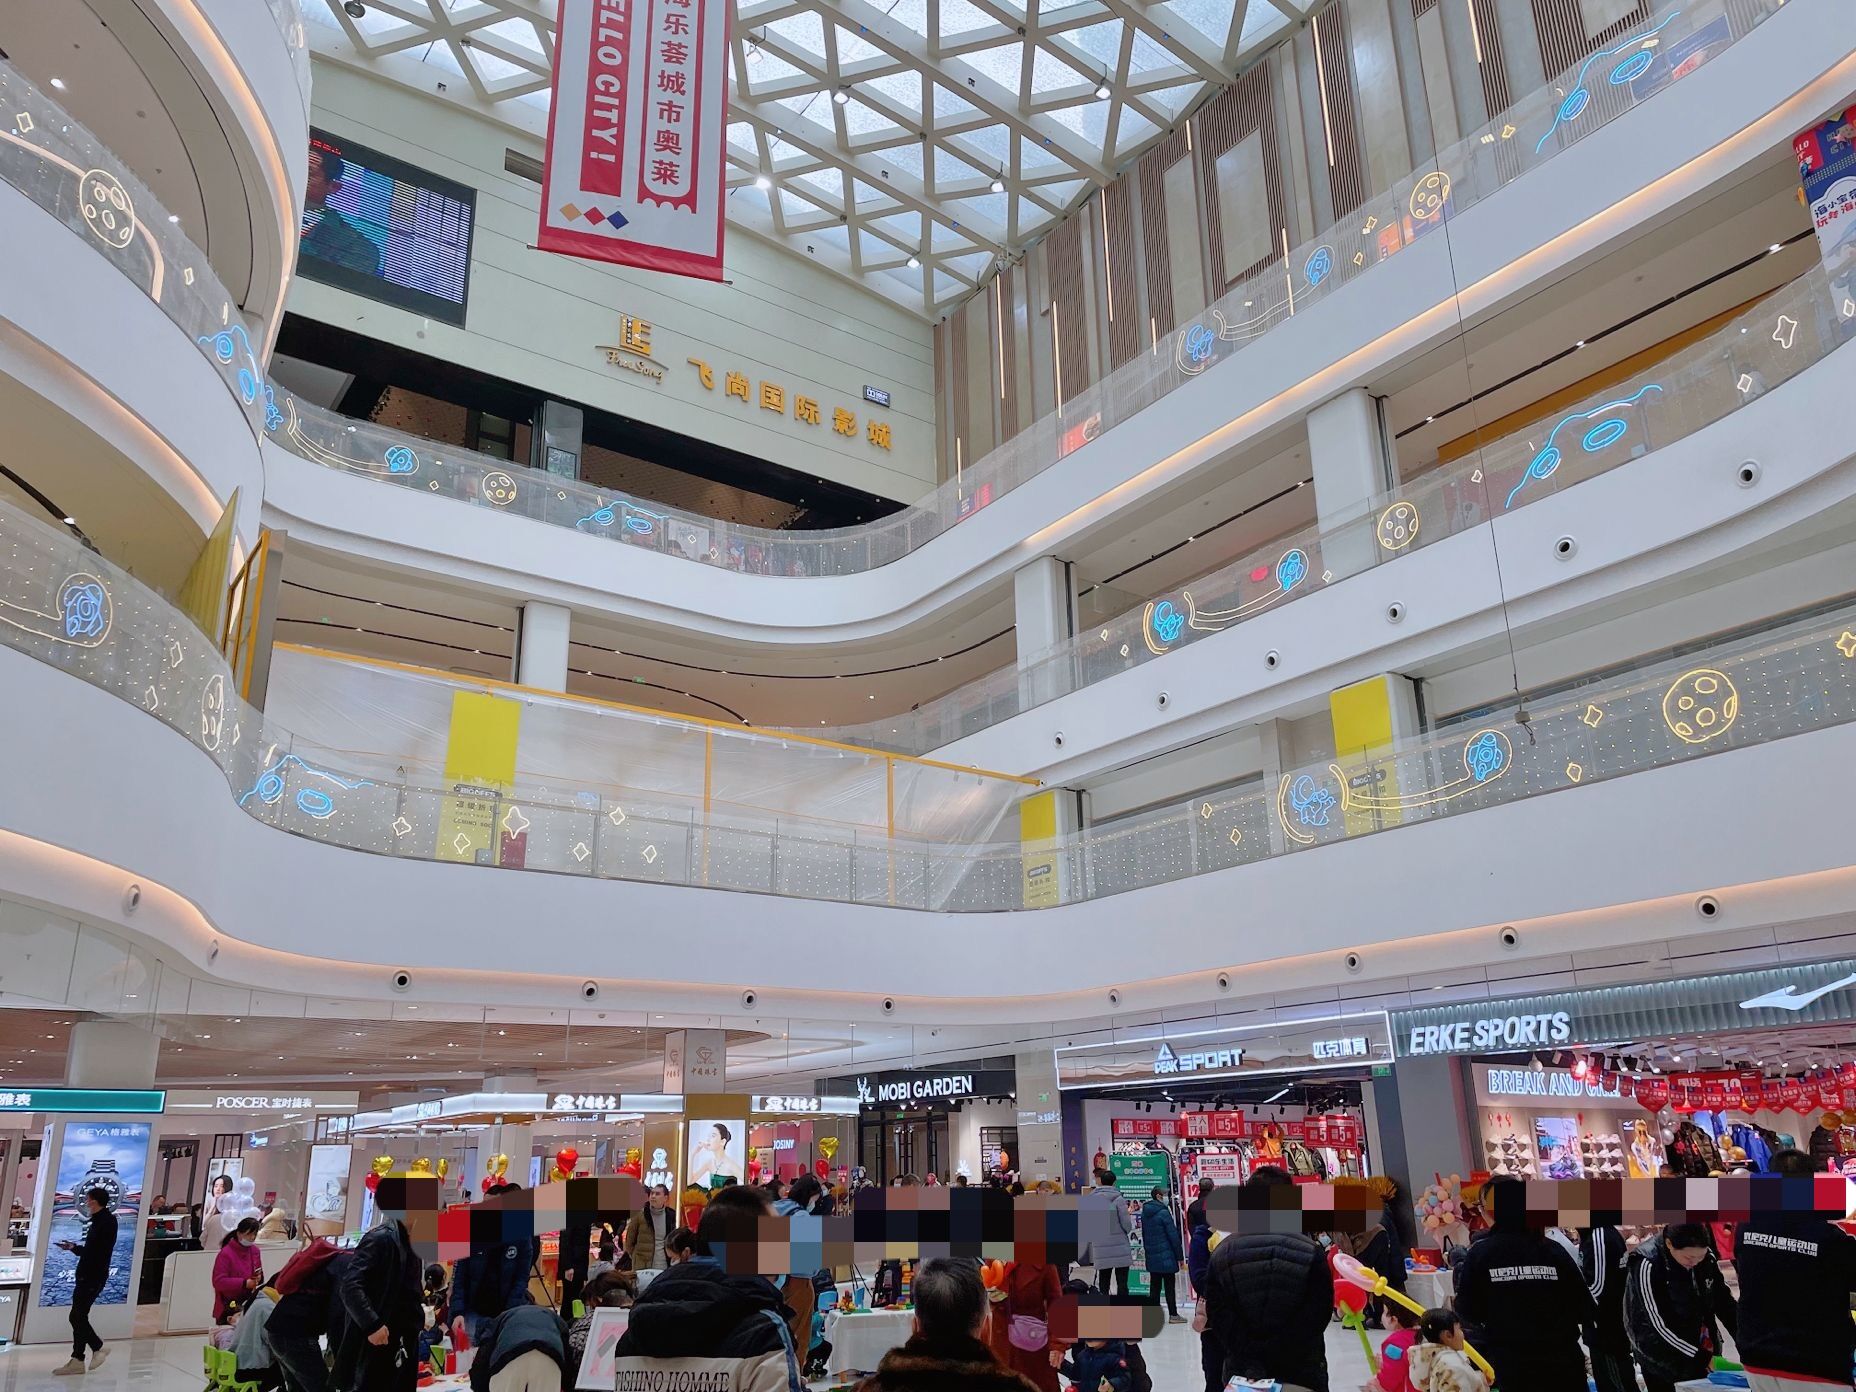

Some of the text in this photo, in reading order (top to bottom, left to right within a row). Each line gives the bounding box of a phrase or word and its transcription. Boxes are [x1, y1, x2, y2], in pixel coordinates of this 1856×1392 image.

[687, 357, 894, 452] 飞尚国际影城
[1410, 1011, 1571, 1054] ERKE SPORTS
[1313, 1037, 1367, 1059] 匹克体育
[1154, 1059, 1179, 1074] PEAK
[878, 1075, 973, 1102] MOBI GARDEN
[1488, 1069, 1547, 1095] BREAK
[1549, 1072, 1583, 1097] AND
[216, 1096, 270, 1109] POSCER
[667, 1371, 730, 1392] HOMME
